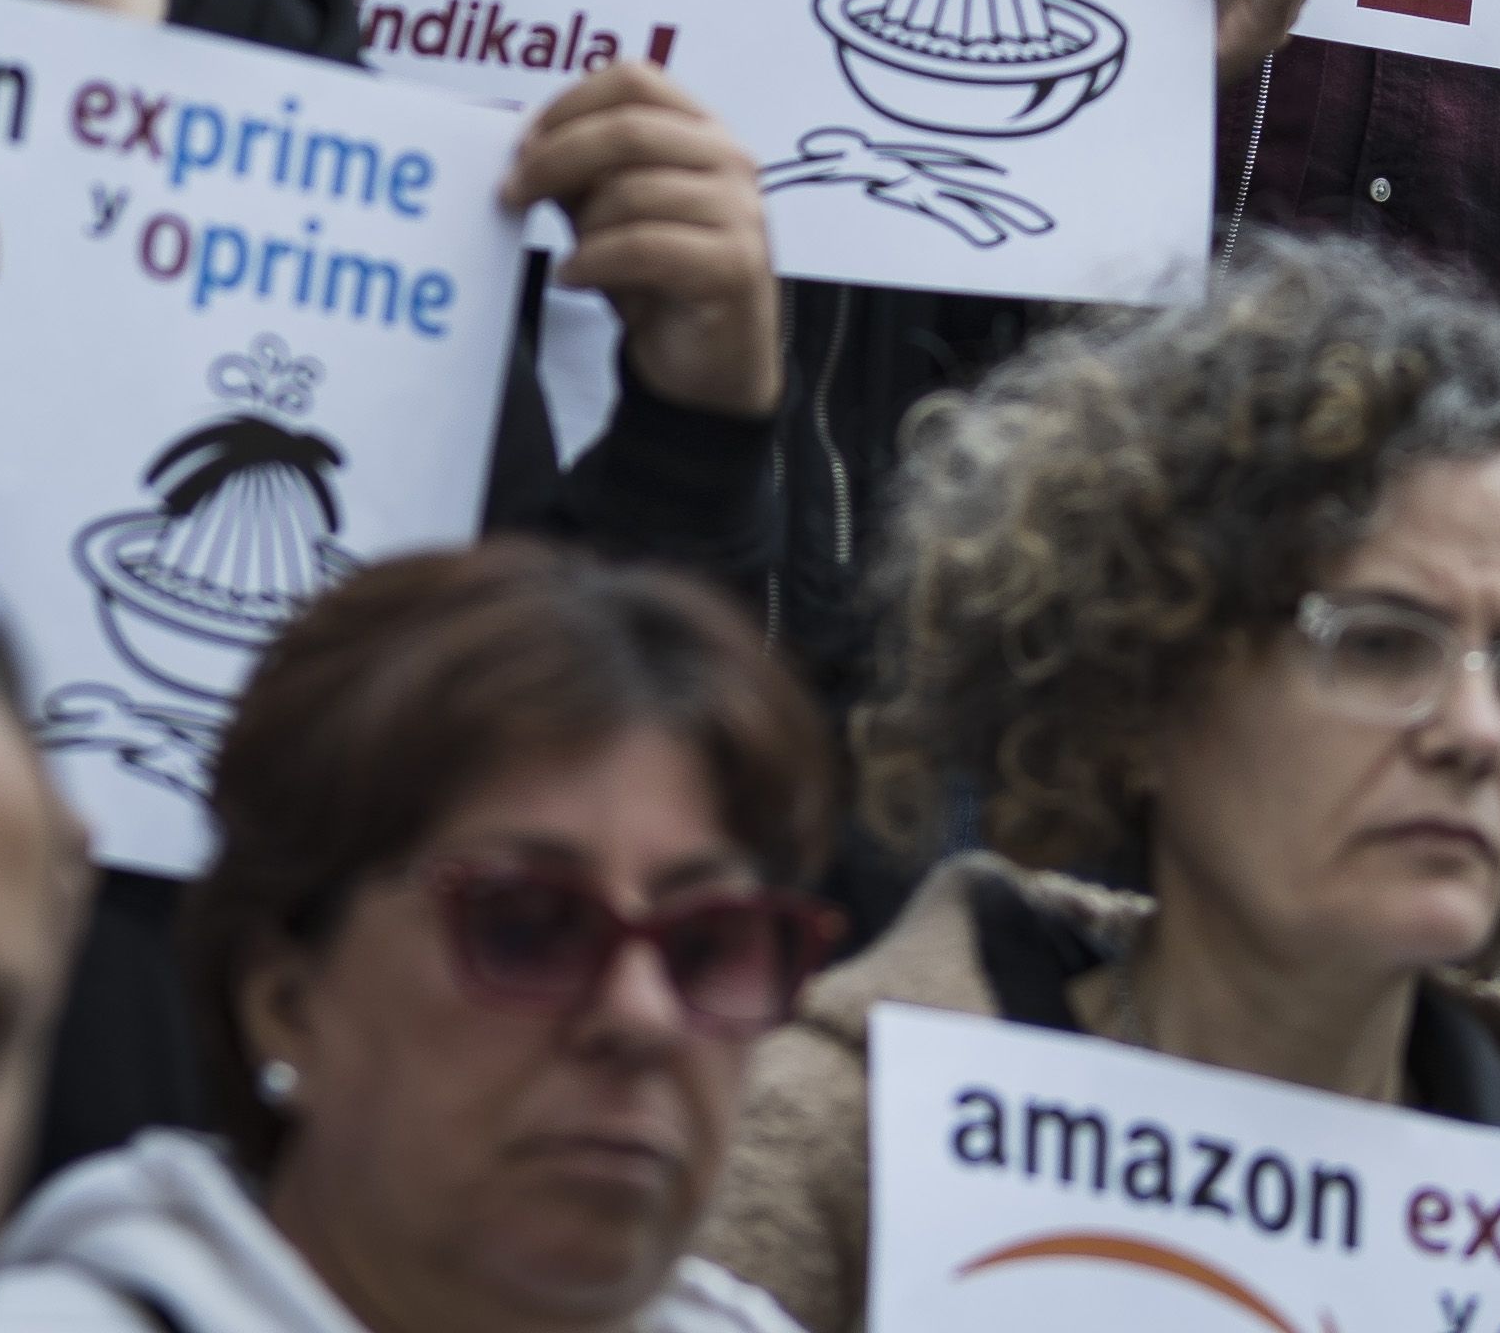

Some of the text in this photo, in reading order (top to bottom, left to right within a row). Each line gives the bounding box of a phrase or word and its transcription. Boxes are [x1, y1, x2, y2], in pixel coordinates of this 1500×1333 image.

[70, 79, 436, 221] exprime
[87, 182, 457, 339] y oprime
[949, 1088, 1360, 1249] amazon
